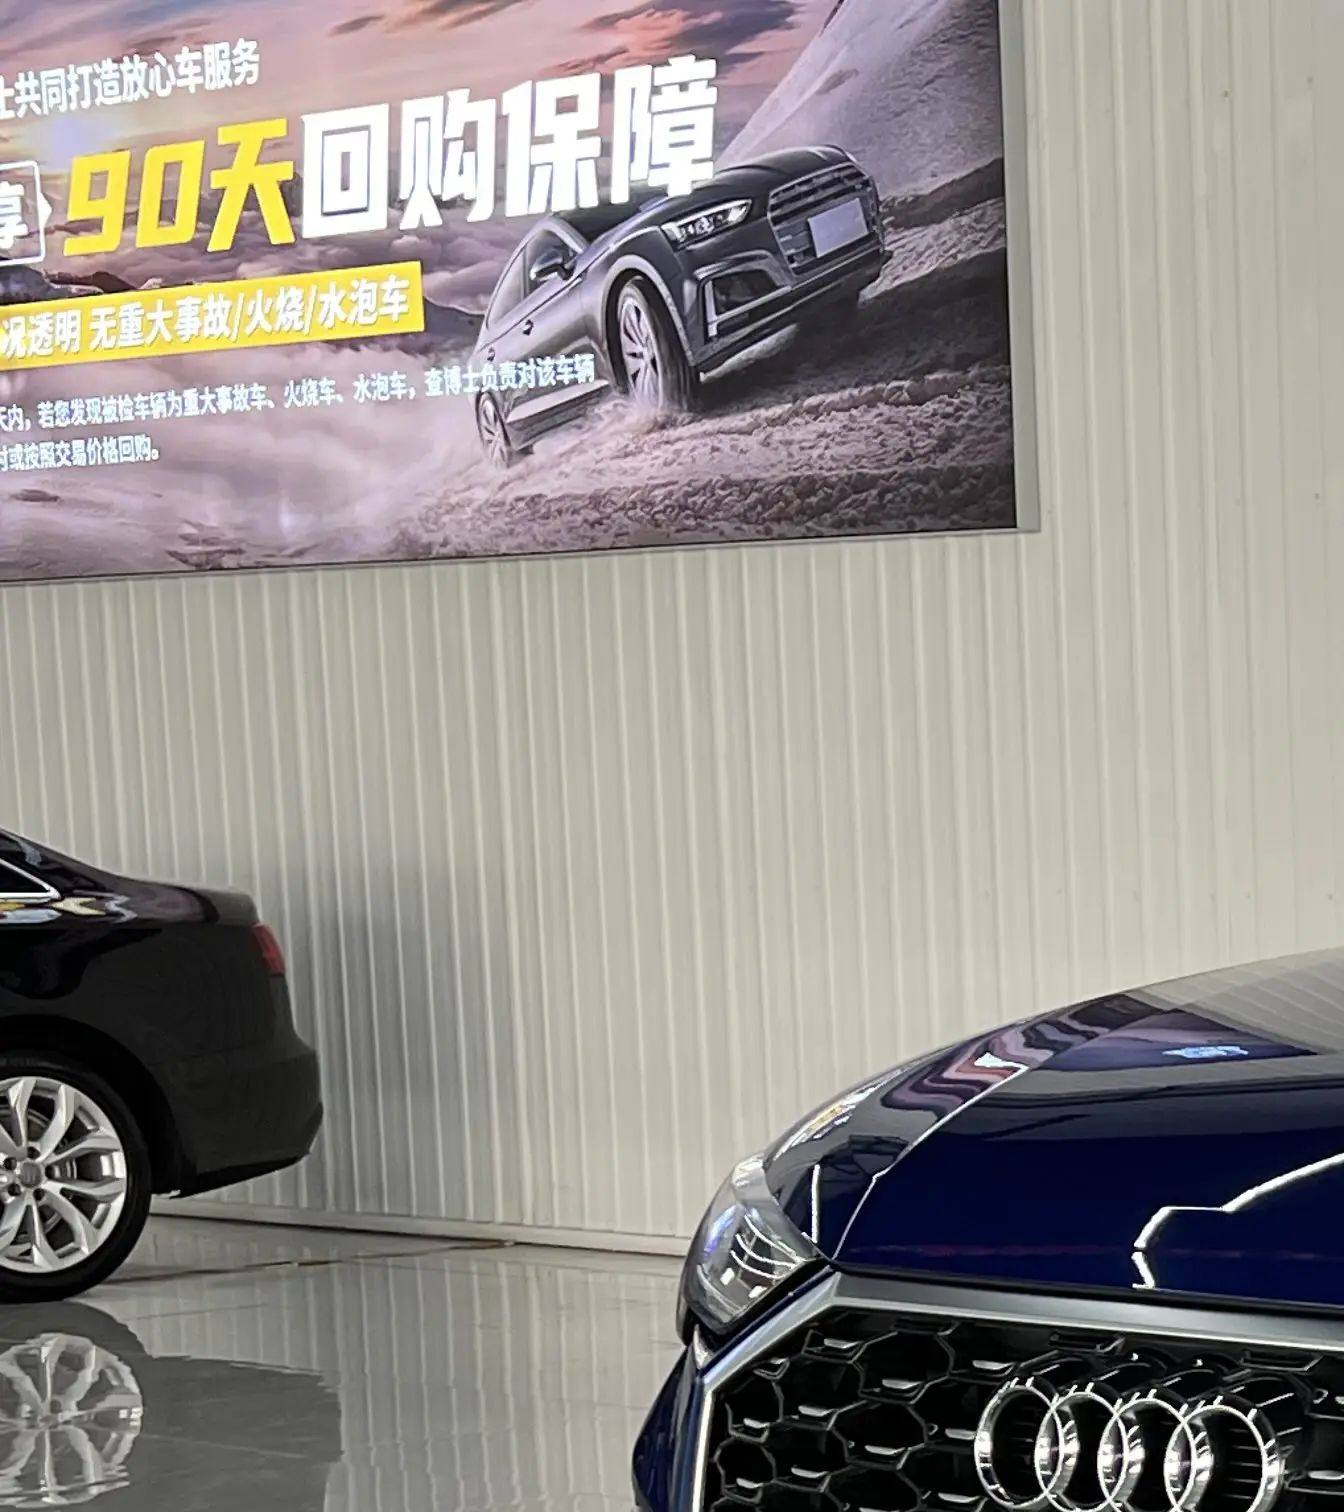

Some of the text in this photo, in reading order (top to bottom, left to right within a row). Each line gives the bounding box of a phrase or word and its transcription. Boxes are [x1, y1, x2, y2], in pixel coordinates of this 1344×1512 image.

[63, 56, 718, 257] 90天回购保障
[89, 273, 411, 350] 无重大事故/火烧/水泡车
